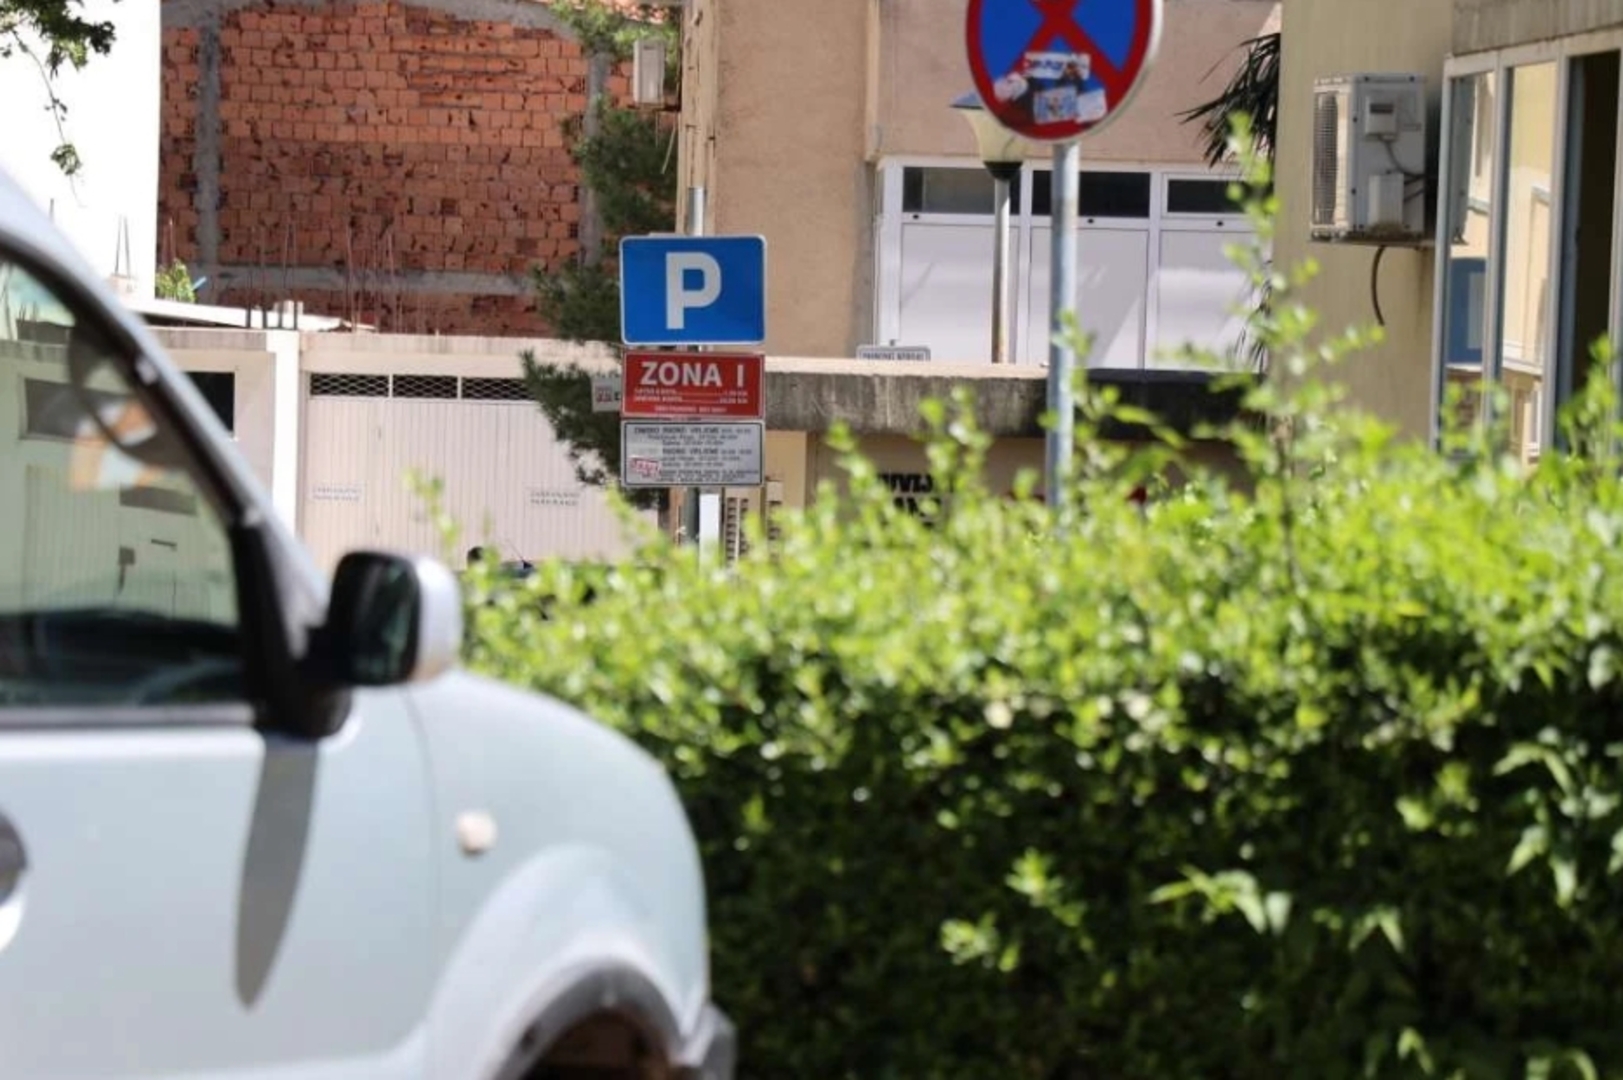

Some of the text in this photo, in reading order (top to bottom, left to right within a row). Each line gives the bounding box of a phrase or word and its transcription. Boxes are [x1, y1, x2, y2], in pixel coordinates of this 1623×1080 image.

[665, 251, 722, 330] P
[640, 361, 745, 388] ZONA I
